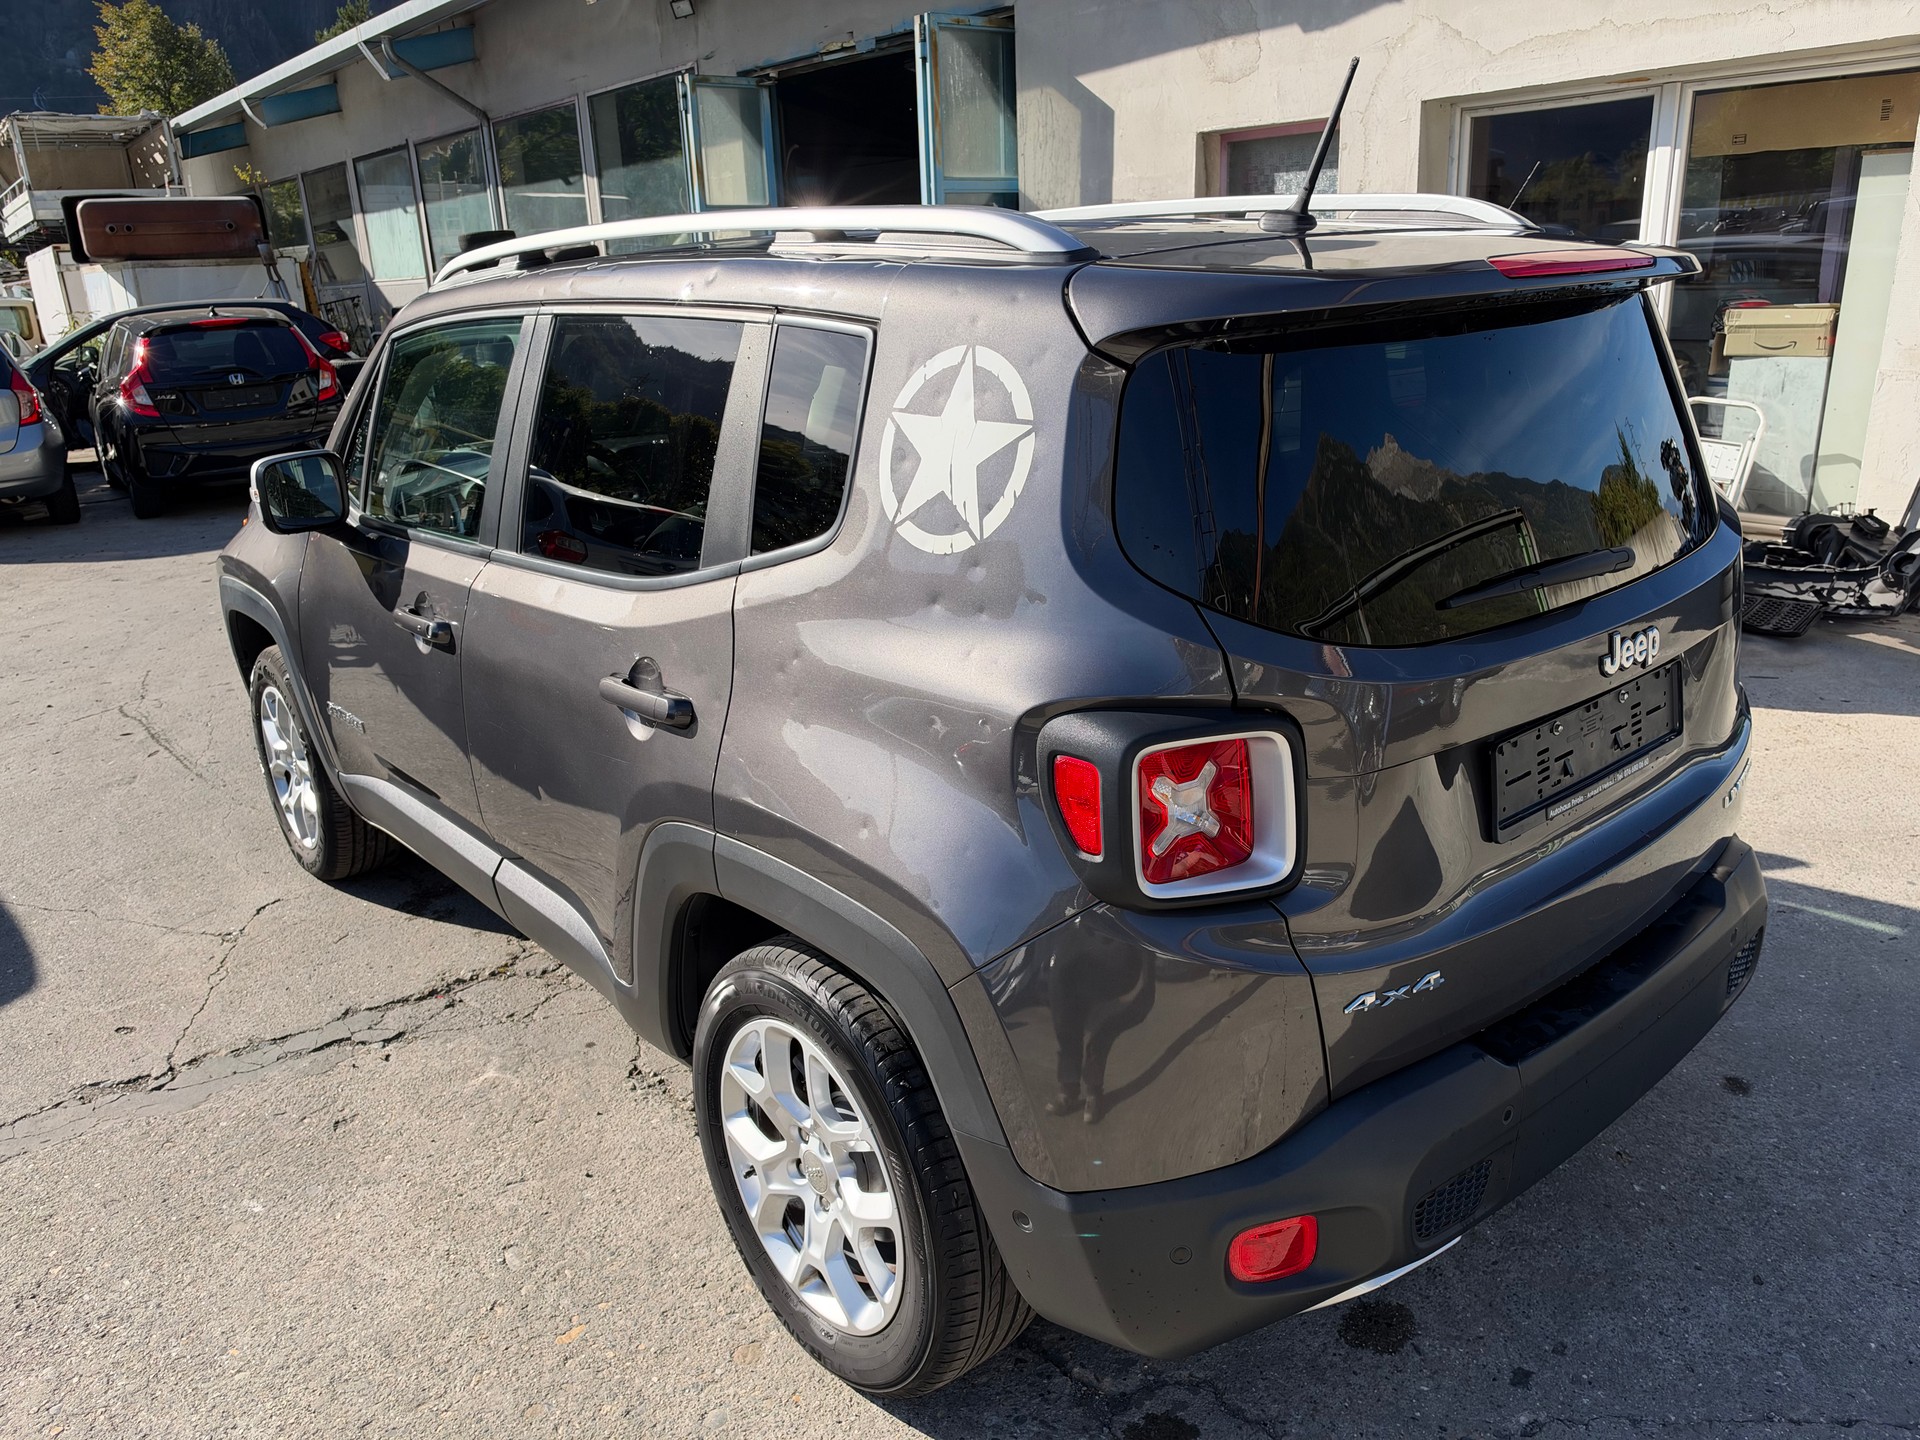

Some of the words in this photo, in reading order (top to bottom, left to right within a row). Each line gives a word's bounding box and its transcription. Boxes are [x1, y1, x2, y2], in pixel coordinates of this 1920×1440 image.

[154, 393, 177, 401] JAZZ
[1600, 625, 1661, 678] Jeep
[1549, 801, 1571, 818] Autohaus
[1343, 969, 1446, 1015] 4x4
